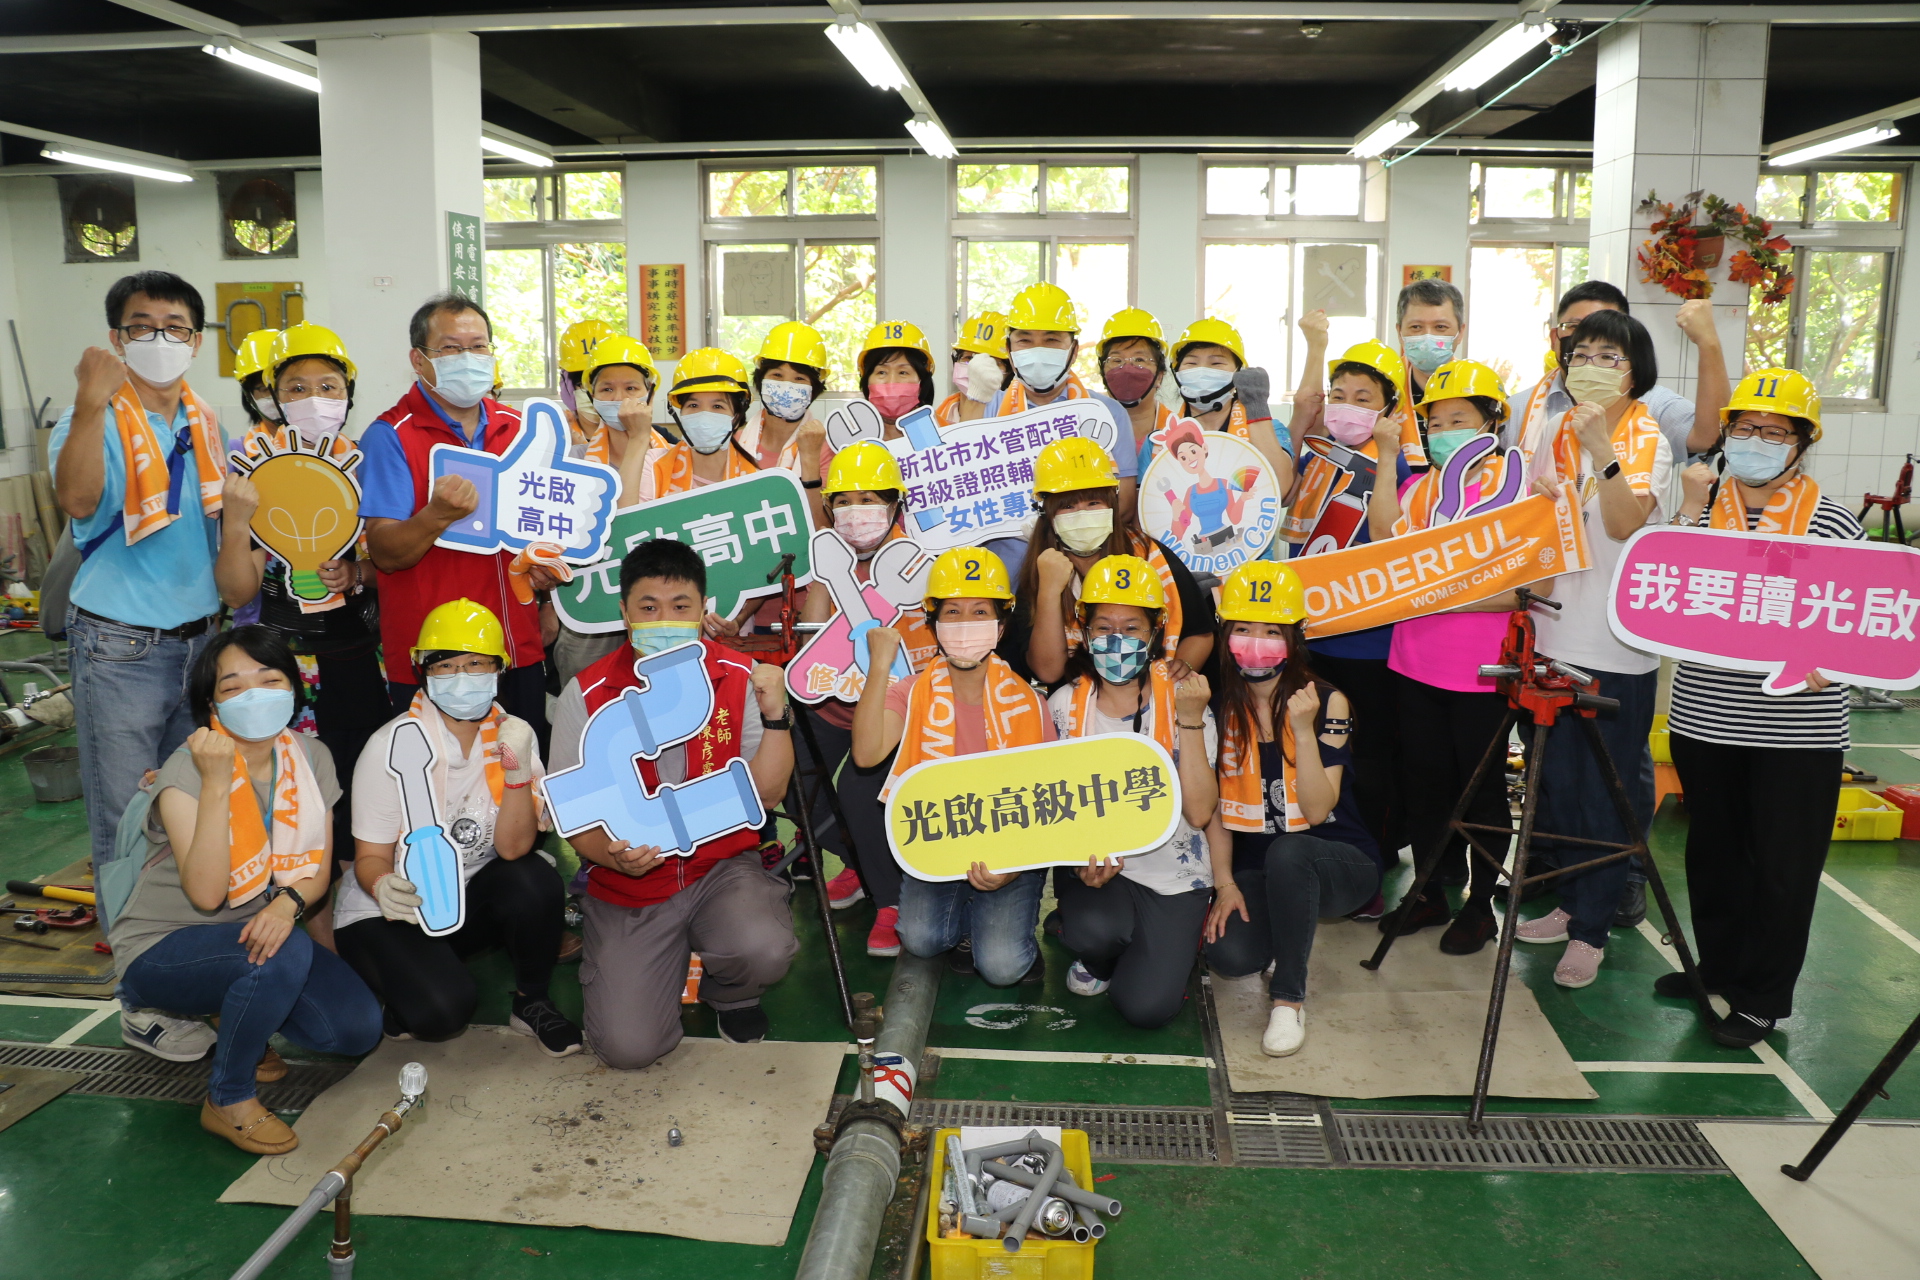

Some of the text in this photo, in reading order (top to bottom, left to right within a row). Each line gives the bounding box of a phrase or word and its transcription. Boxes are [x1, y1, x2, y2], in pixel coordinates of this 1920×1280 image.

[883, 324, 903, 340] 18
[973, 322, 994, 341] 10
[1437, 371, 1452, 390] 7
[1753, 378, 1778, 398] 11
[897, 414, 1080, 482] 新北市水管配管
[1070, 454, 1087, 469] 11
[518, 471, 576, 505] 光啟
[904, 454, 1038, 513] 丙級證照輔
[517, 506, 573, 540] 高中
[1160, 496, 1277, 573] Women Can
[1555, 505, 1575, 552] NTPC
[964, 559, 982, 581] 2
[1115, 568, 1131, 590] 3
[1304, 519, 1523, 617] ONDERFUL
[1410, 552, 1528, 609] WOMEN CAN BE
[1249, 580, 1272, 603] 12
[1628, 562, 1920, 642] 我要讀光啟
[808, 664, 897, 697] 修水
[715, 707, 732, 745] 老師
[899, 765, 1167, 846] 光啟高級中學
